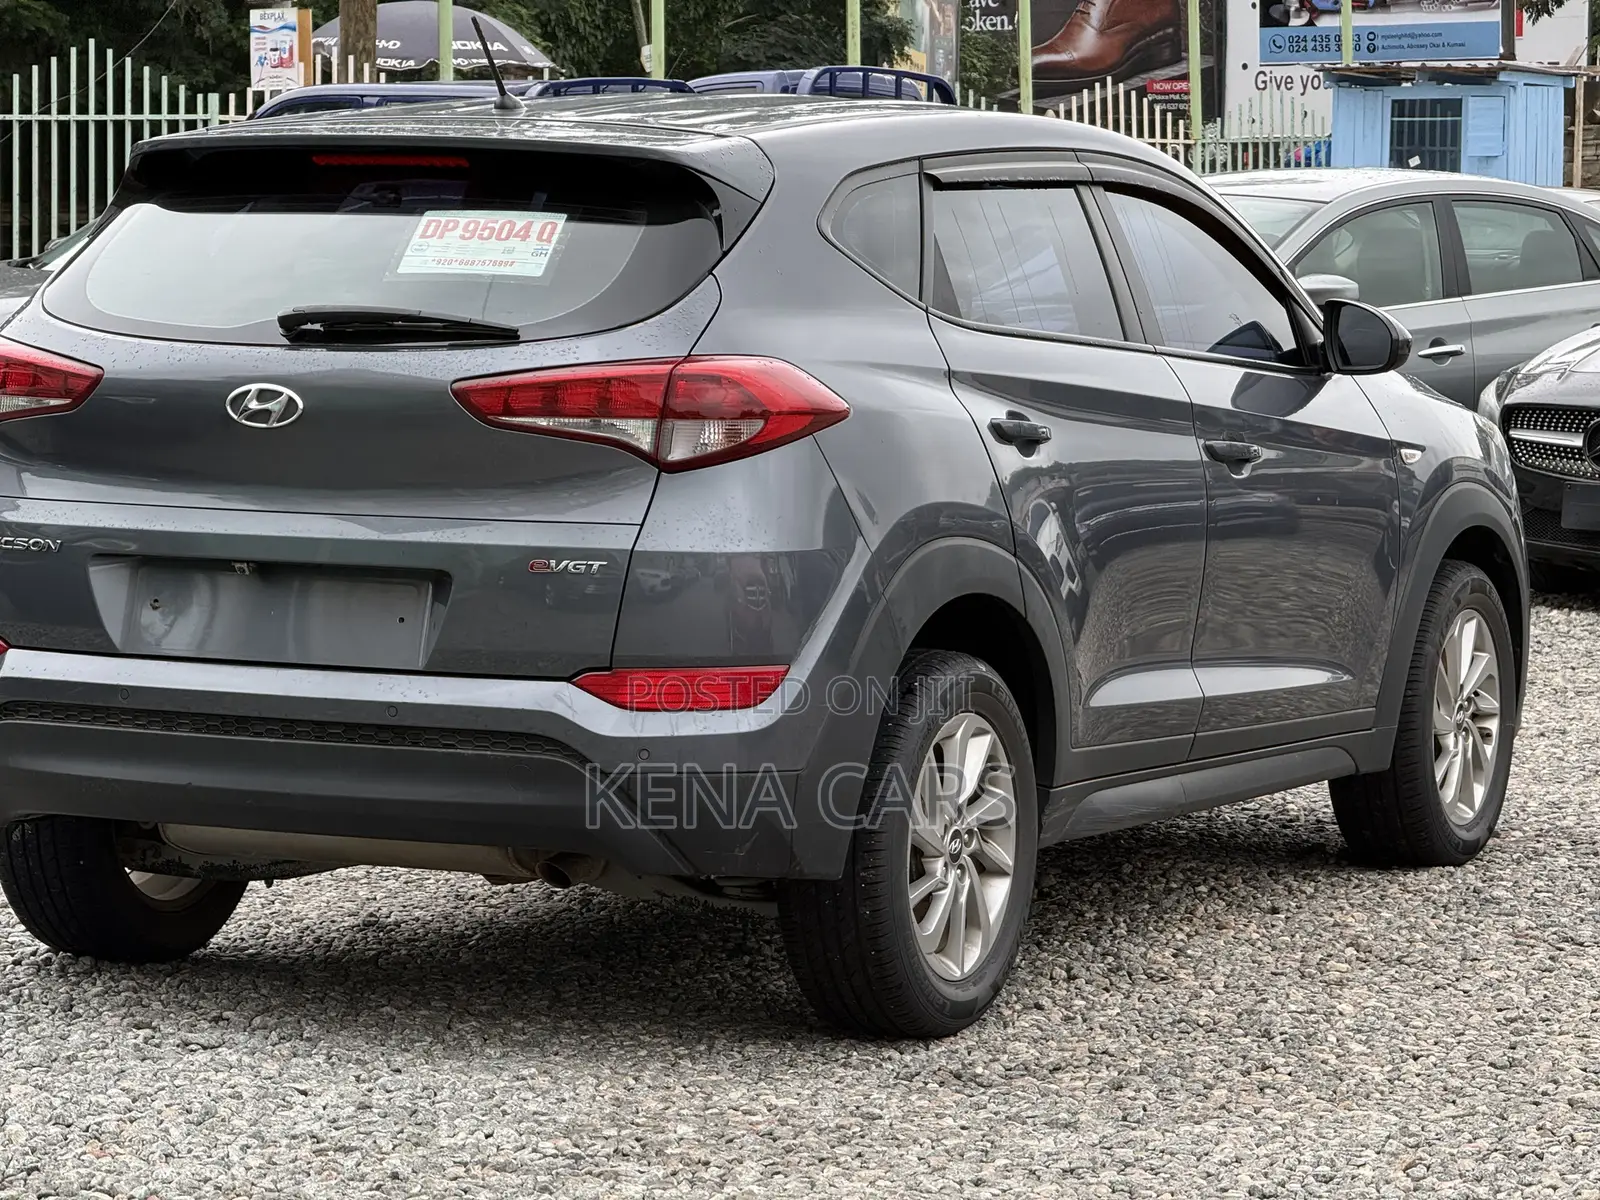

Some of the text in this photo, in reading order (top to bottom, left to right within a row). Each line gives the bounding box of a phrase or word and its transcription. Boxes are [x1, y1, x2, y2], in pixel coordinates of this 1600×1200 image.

[1288, 34, 1361, 44] 024 435 03
[1288, 43, 1361, 53] 024 435 30
[1153, 82, 1190, 90] NOW OPE
[1254, 70, 1332, 97] Give yo
[418, 218, 559, 244] DP 9504 Q
[0, 536, 61, 552] CSON
[528, 559, 608, 574] eVGT
